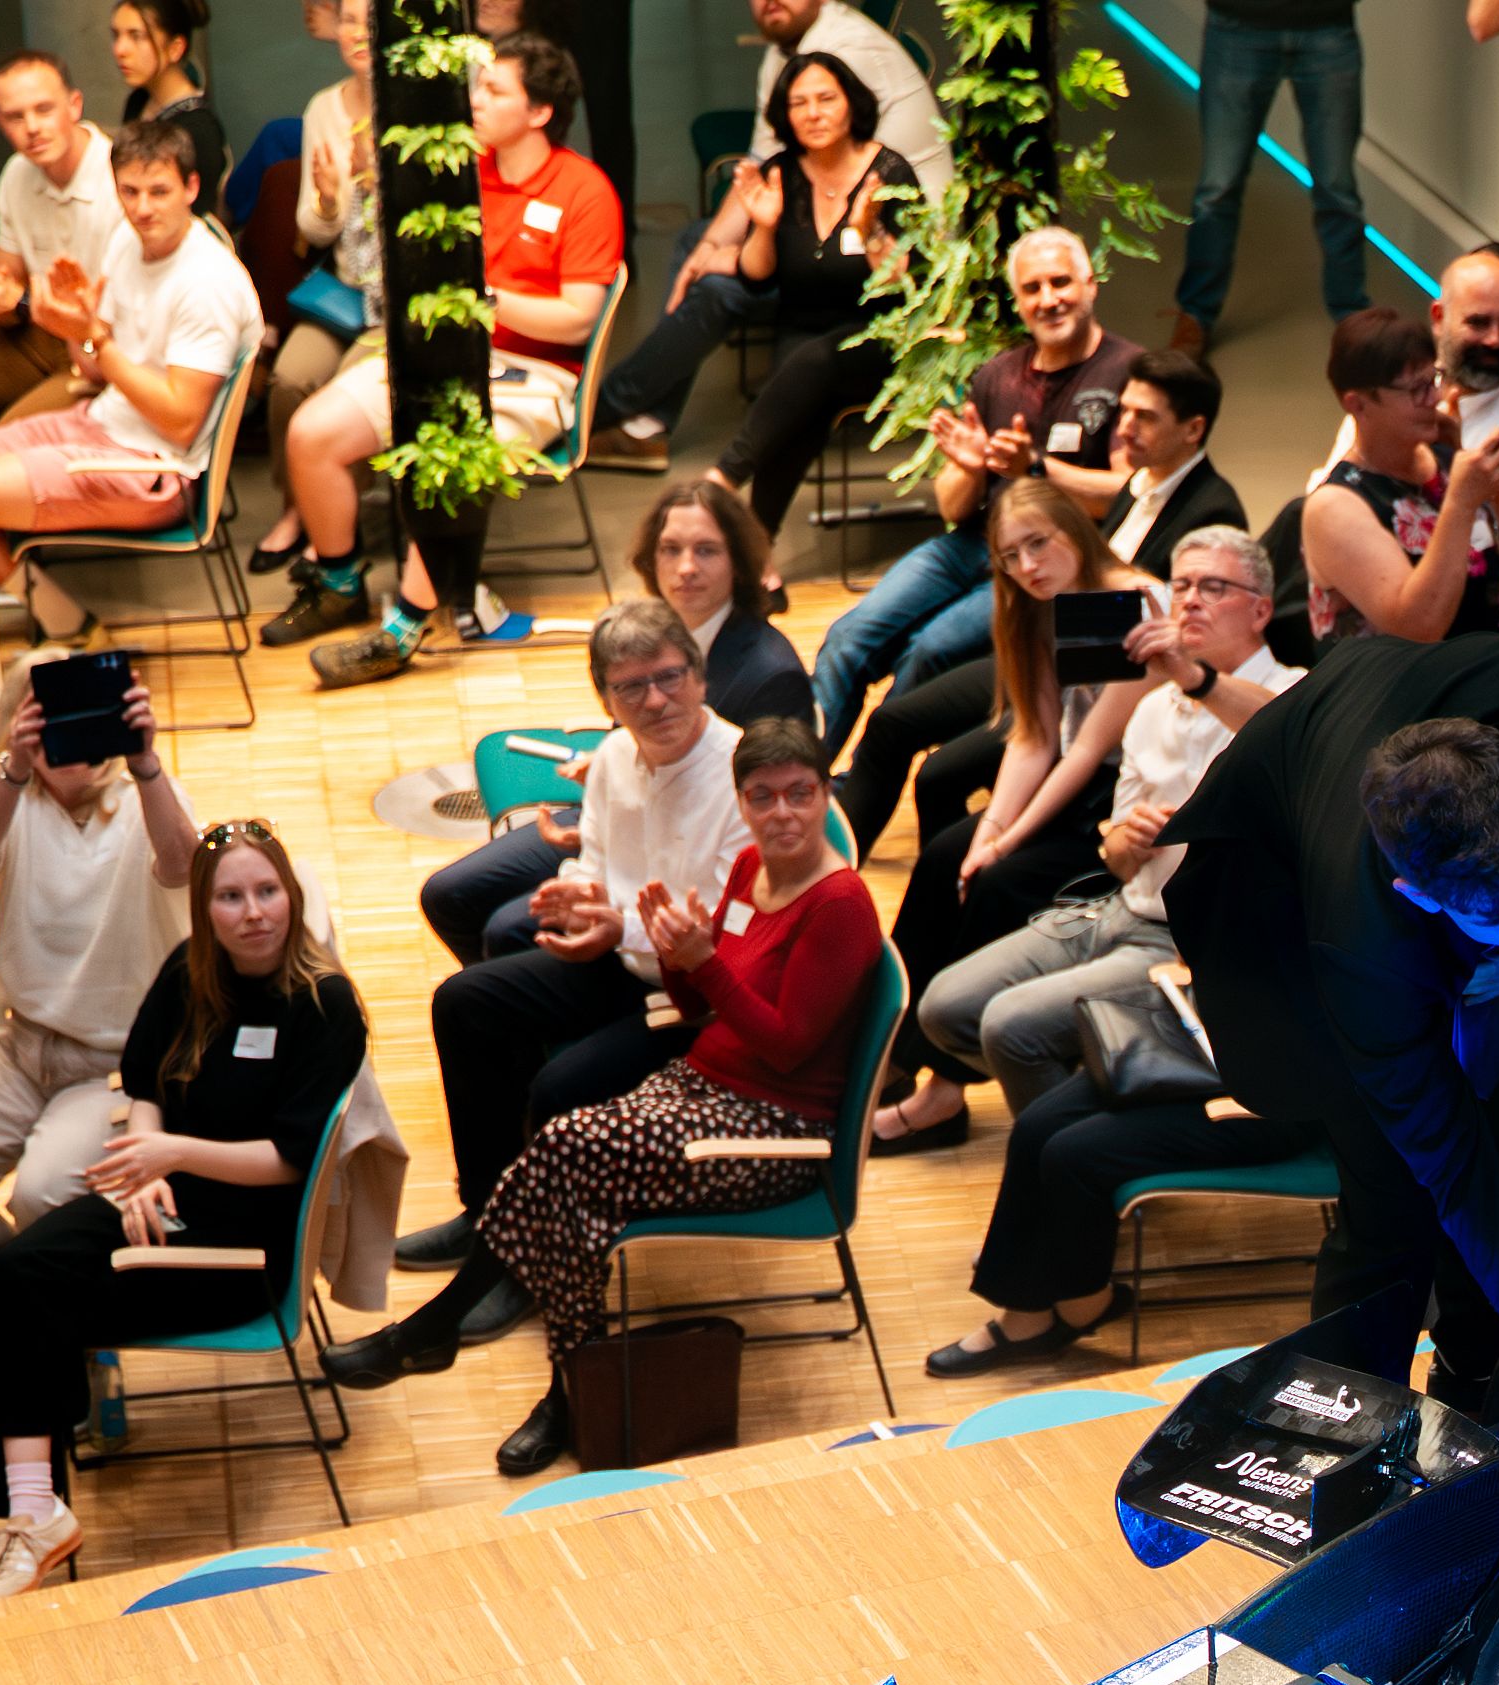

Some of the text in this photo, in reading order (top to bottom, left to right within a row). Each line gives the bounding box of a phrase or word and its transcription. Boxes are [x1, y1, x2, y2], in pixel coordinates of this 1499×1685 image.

[1278, 1393, 1349, 1420] SIMRACING CENTER
[1214, 1451, 1315, 1492] Nexans
[1238, 1478, 1302, 1500] autoelectric
[1159, 1493, 1303, 1546] COMPLETE AND FLEXIBLE SMT SOLUTIONS
[1169, 1482, 1313, 1541] FRITSCH
